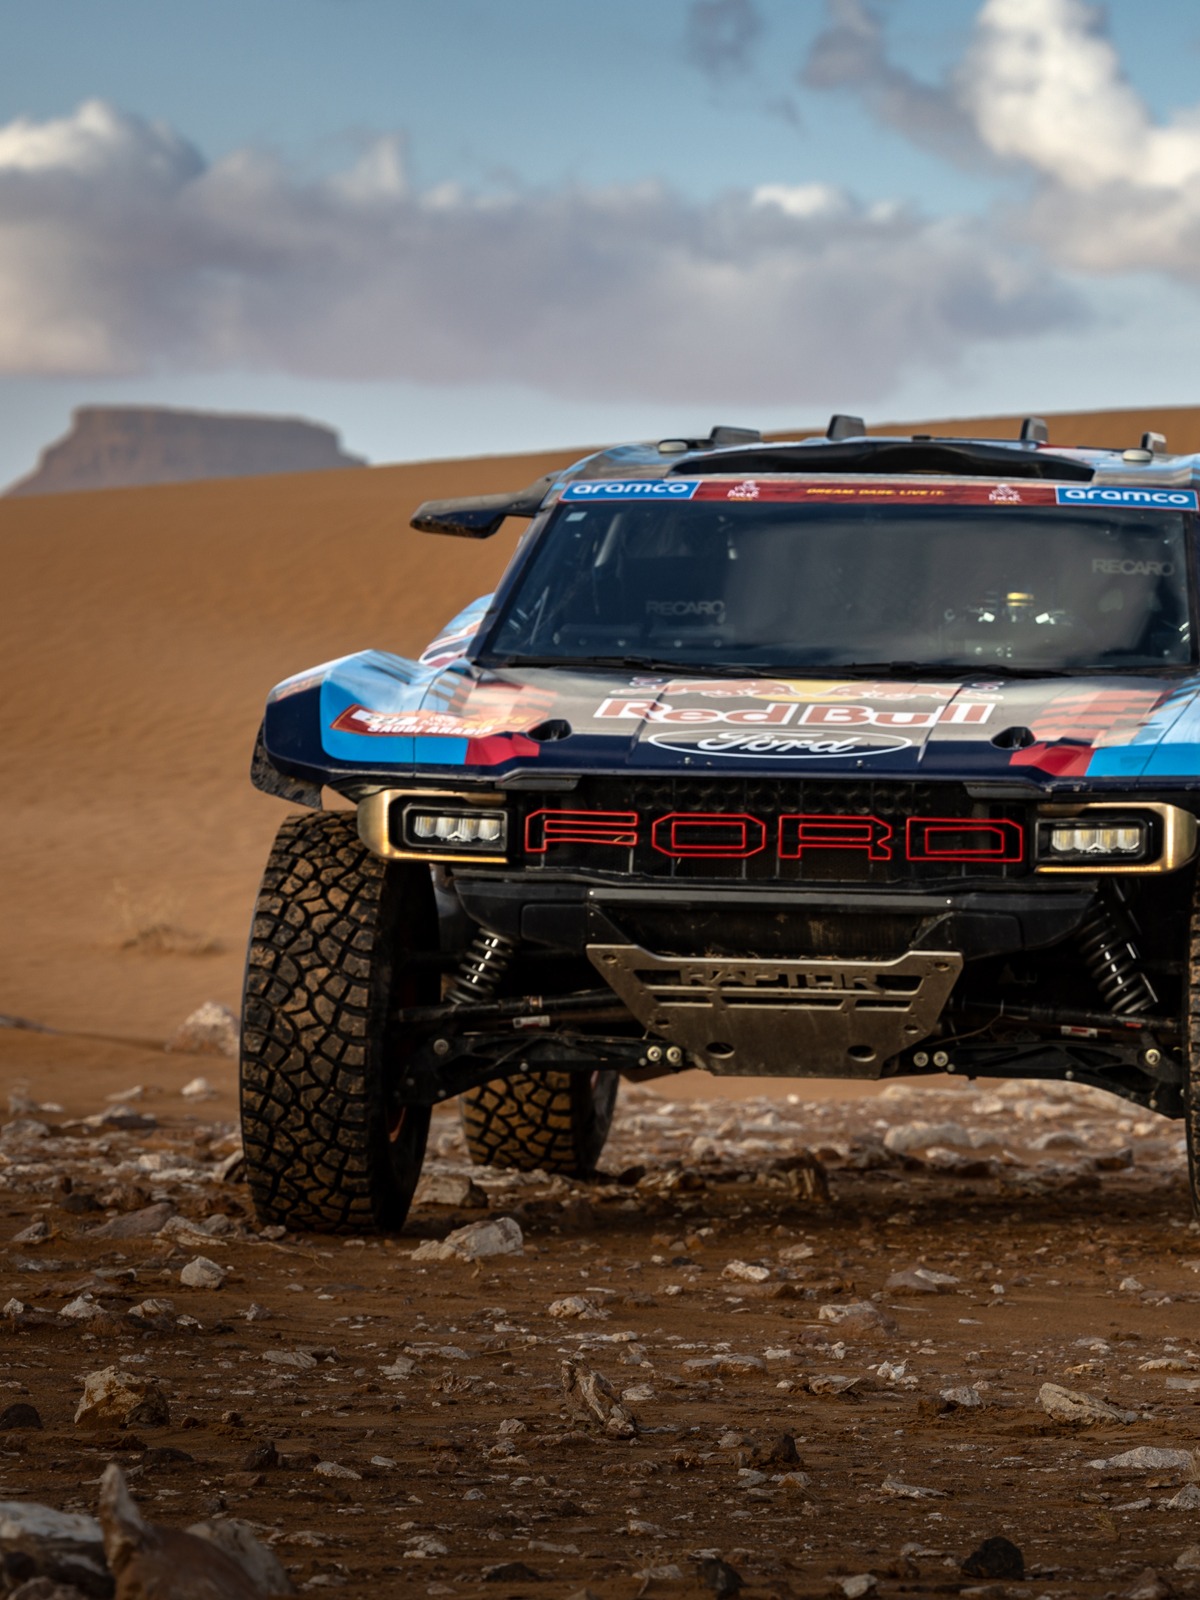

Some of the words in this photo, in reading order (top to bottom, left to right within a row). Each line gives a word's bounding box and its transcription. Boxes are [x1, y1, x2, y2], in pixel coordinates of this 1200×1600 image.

[572, 482, 689, 495] aramco
[1065, 489, 1189, 504] aramco
[1092, 559, 1175, 576] RECARO
[646, 600, 725, 616] RECARO
[593, 698, 797, 726] Red
[798, 703, 996, 727] Bull
[697, 731, 863, 753] Ford
[524, 809, 1024, 862] FORD
[680, 969, 886, 995] RAPTOR
